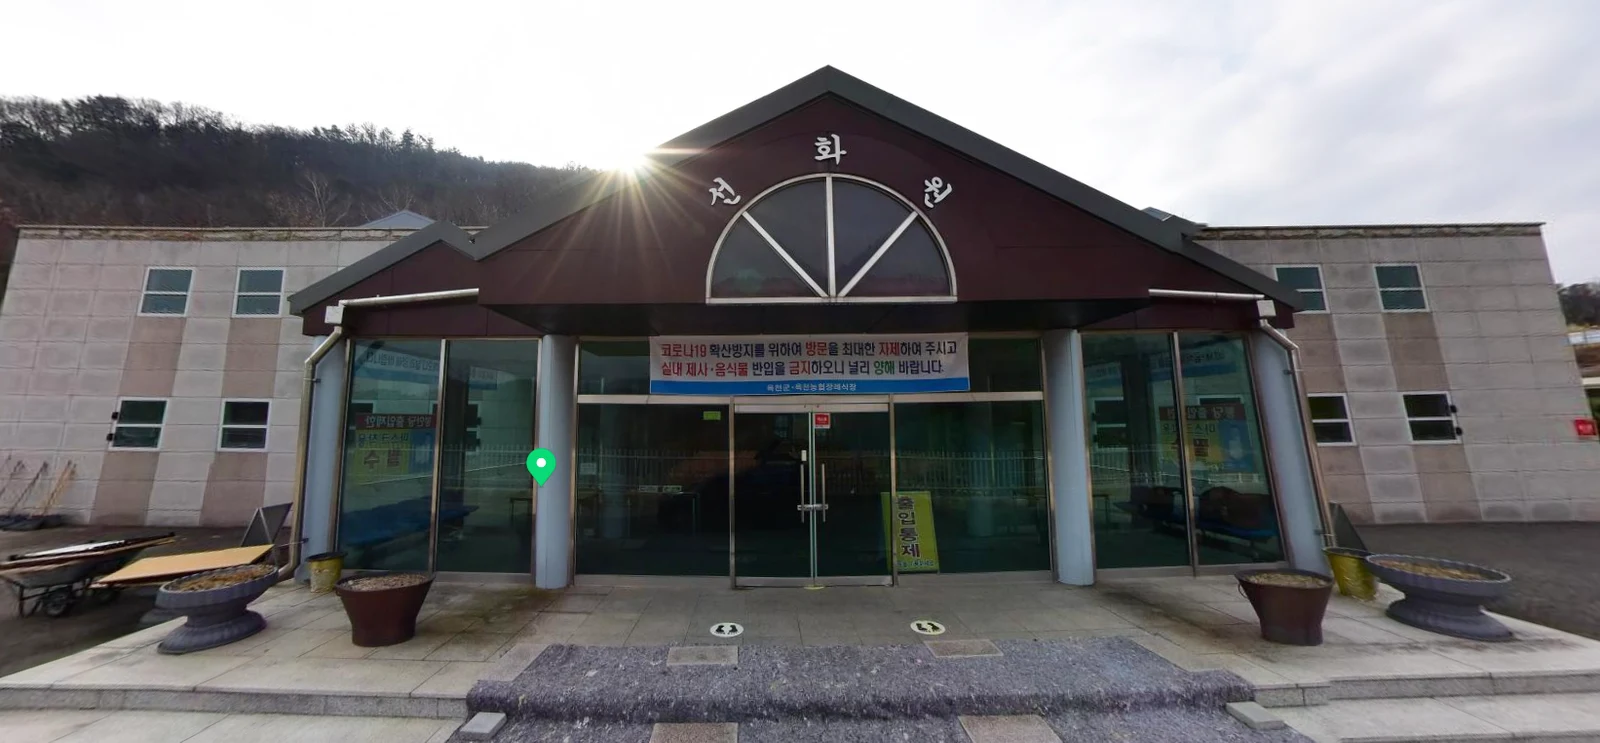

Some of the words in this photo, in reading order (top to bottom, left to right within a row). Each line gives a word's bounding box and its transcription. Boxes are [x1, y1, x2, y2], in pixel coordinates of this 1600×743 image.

[660, 343, 707, 358] 코로나19
[709, 343, 765, 358] 확산방지를
[768, 342, 802, 357] 위하여
[805, 341, 839, 356] 방문을
[842, 341, 875, 356] 최대한
[878, 341, 922, 356] 자제하여
[925, 341, 957, 355] 주시고
[661, 361, 683, 377] 실내
[752, 361, 785, 376] 반입을
[788, 360, 844, 376] 금지하오니
[848, 360, 870, 375] 널리
[873, 360, 895, 375] 양해
[899, 360, 944, 375] 바랍니다.
[897, 495, 920, 558] 출입통제
